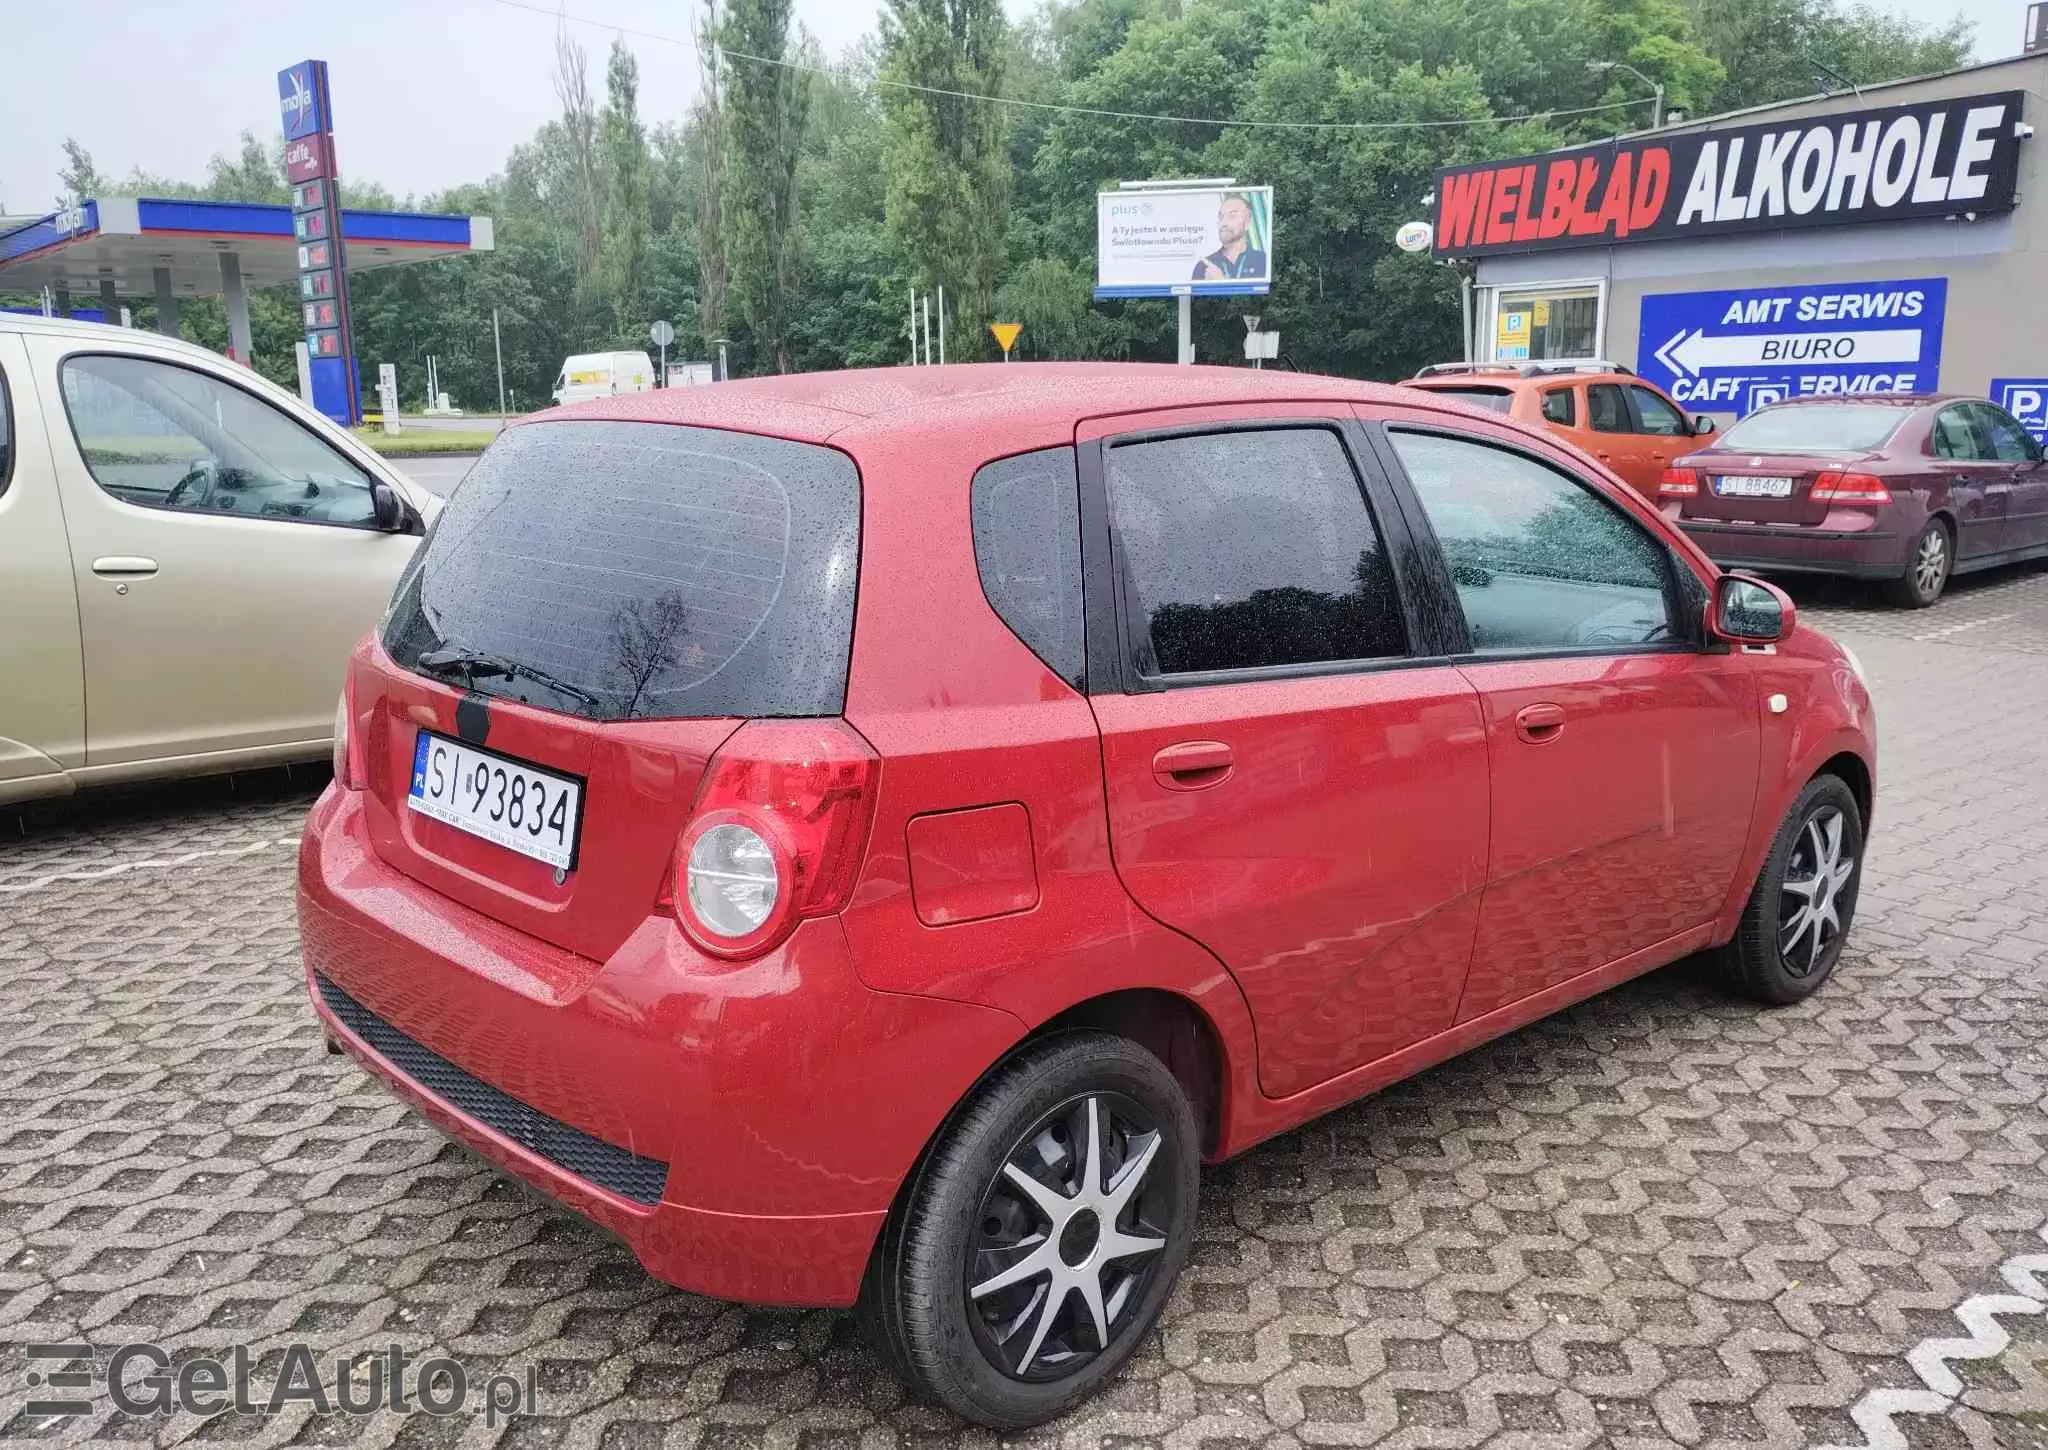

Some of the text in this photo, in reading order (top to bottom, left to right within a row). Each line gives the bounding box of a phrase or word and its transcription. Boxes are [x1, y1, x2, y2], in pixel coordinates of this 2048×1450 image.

[1437, 105, 2007, 249] WIELBŁĄD ALKOHOLE
[1111, 204, 1138, 217] plus
[1721, 291, 1925, 325] AMT SERWIS
[1761, 337, 1856, 361] BIURO
[1671, 374, 1917, 402] CAFF ERVICE
[1745, 478, 1788, 492] 88467
[430, 746, 460, 806] SI
[471, 761, 569, 847] 93834
